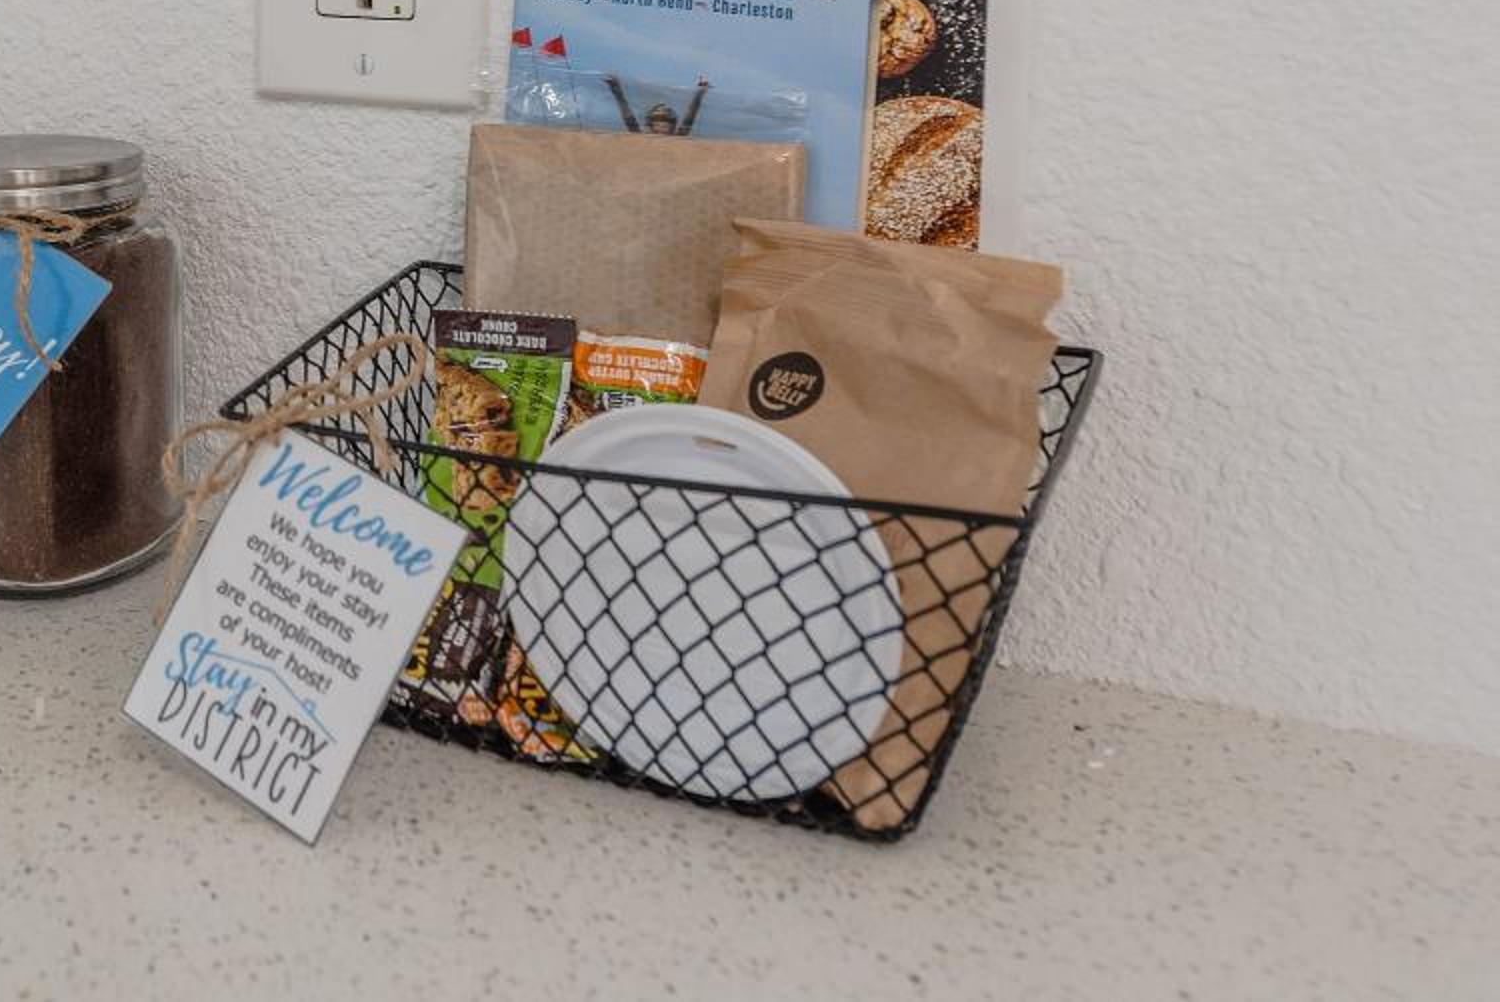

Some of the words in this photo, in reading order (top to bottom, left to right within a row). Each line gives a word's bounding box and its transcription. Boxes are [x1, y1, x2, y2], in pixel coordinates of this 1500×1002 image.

[765, 380, 809, 406] BELLY
[767, 367, 817, 391] HAPPY
[259, 443, 437, 577] Welcome
[270, 512, 298, 545] We
[301, 530, 346, 571] hope
[349, 563, 385, 596] you
[247, 535, 294, 576] enjoy
[298, 566, 338, 599] your
[340, 592, 389, 631] stay!
[249, 565, 300, 610] These
[304, 596, 354, 642] items
[216, 581, 244, 607] are
[247, 600, 362, 681] compliments
[219, 613, 240, 636] of
[242, 632, 282, 665] your
[284, 654, 332, 695] host!
[165, 631, 259, 718] Stay
[251, 685, 278, 727] in
[280, 713, 329, 761] my
[158, 677, 321, 817] DISTRICT
